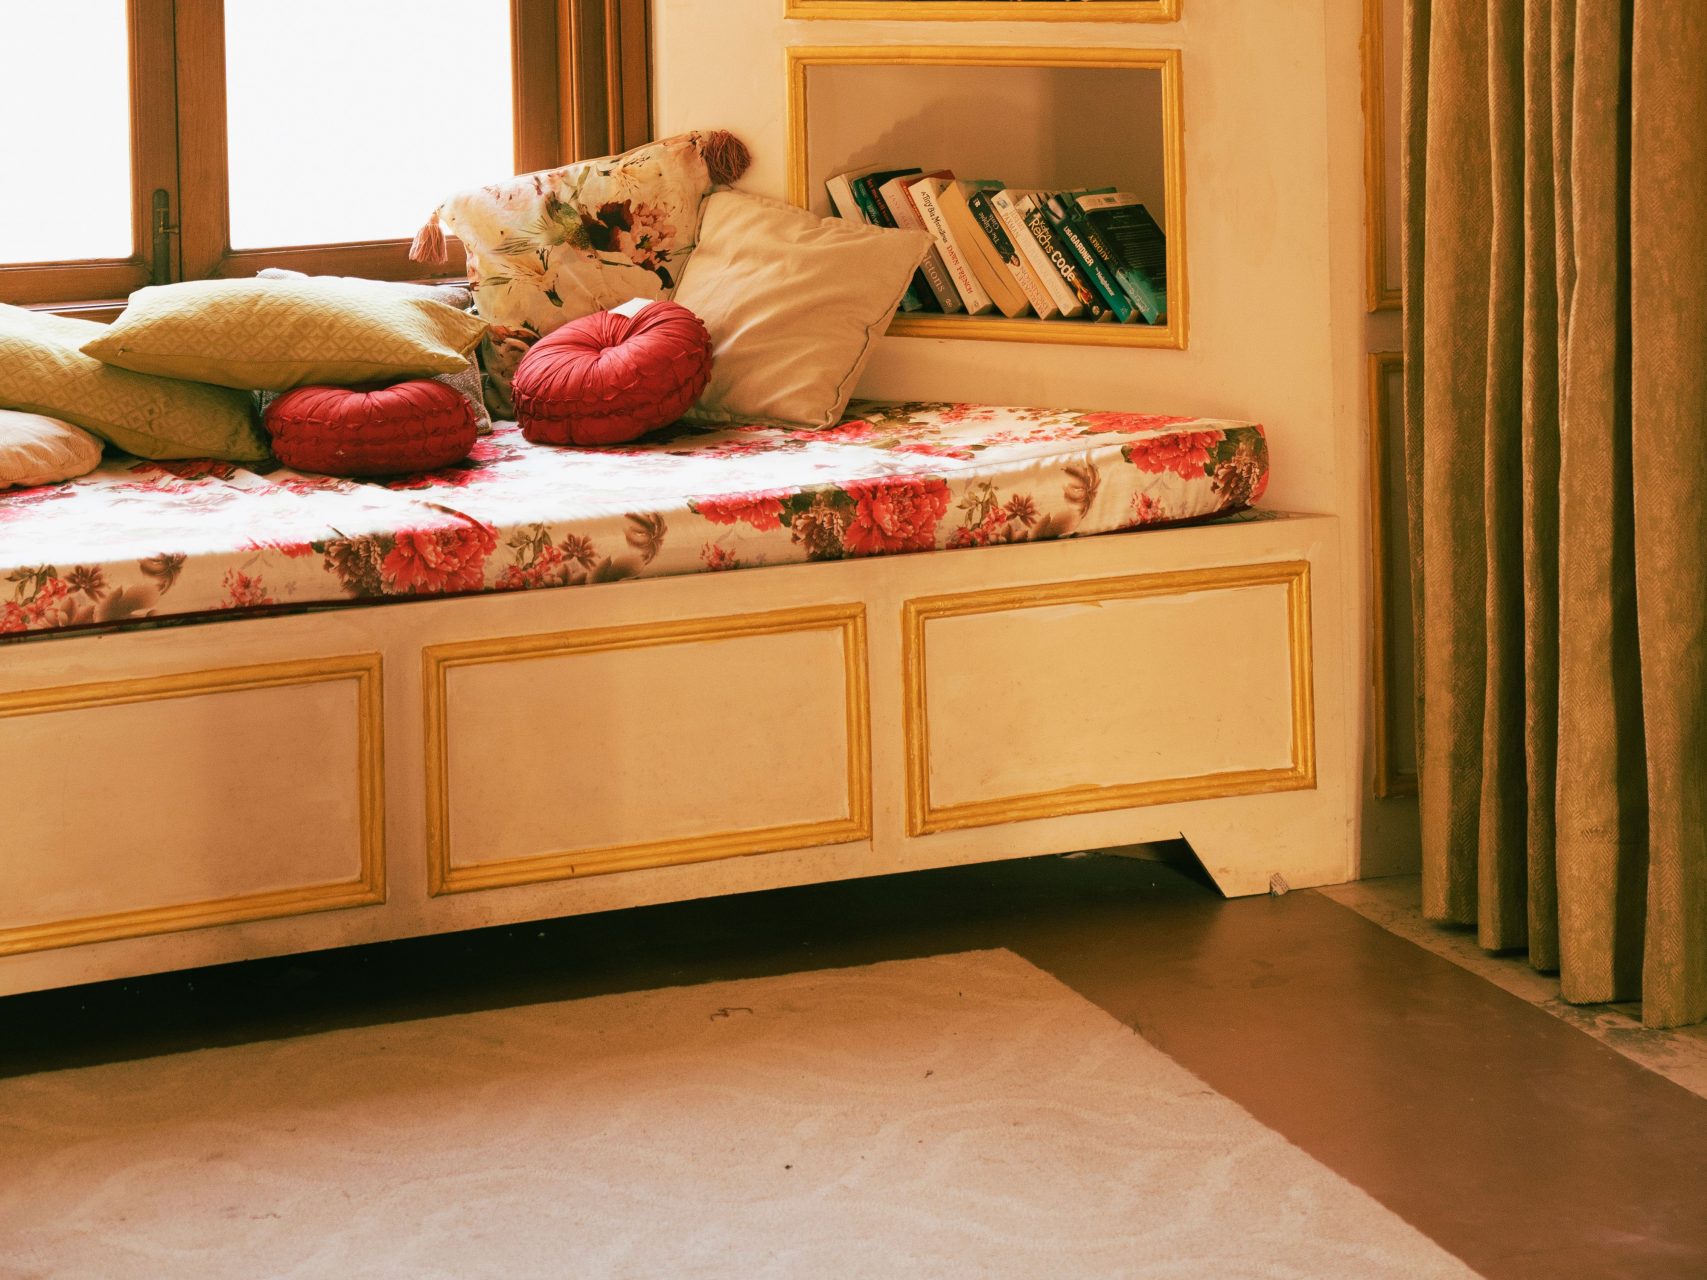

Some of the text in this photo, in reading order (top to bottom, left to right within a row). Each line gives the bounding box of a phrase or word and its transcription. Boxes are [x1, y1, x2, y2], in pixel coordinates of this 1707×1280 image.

[989, 231, 1000, 244] The
[1027, 217, 1056, 255] Reichs
[1048, 248, 1079, 284] code
[1069, 233, 1095, 267] GARDNER
[1086, 233, 1110, 262] AUDREY
[945, 244, 974, 294] DAWN FRENCH
